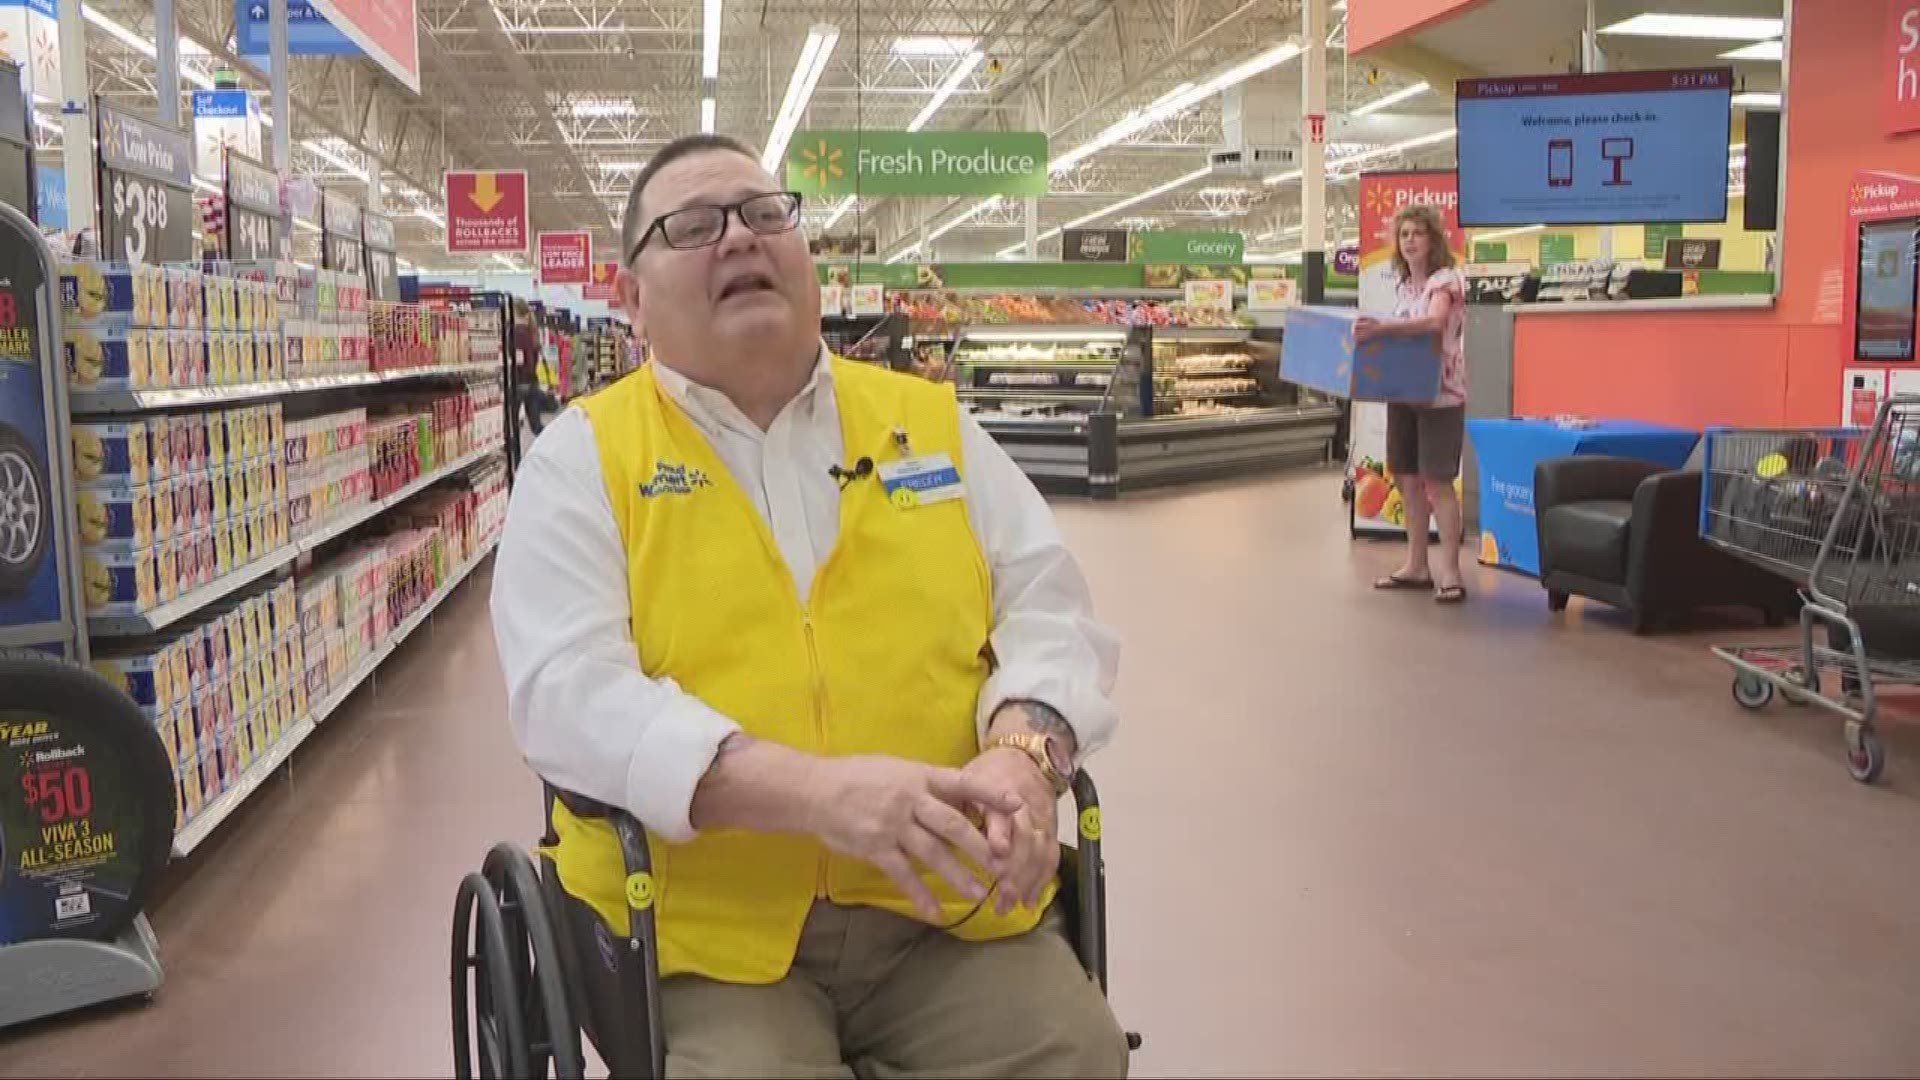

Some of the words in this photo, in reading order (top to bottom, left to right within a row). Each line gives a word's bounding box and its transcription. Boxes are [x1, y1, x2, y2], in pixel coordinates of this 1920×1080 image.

[1700, 73, 1719, 85] PM
[1478, 83, 1515, 96] Pickup
[196, 105, 239, 116] Checkout
[1574, 113, 1609, 126] please
[123, 131, 147, 164] Low
[146, 141, 174, 174] Price
[857, 148, 923, 174] Fresh
[931, 148, 1034, 175] Produce
[1395, 187, 1458, 210] Pickup
[1864, 184, 1899, 199] Pickup
[456, 216, 504, 228] Thousands
[507, 216, 518, 228] of
[456, 227, 519, 238] ROLLBACKS
[1187, 240, 1236, 257] Grocery
[543, 257, 585, 268] LEADER
[36, 744, 85, 763] Rollback
[22, 767, 92, 821] $50
[41, 824, 77, 845] VIVA
[80, 821, 91, 837] 3
[20, 832, 114, 869] ALL-SEASON
